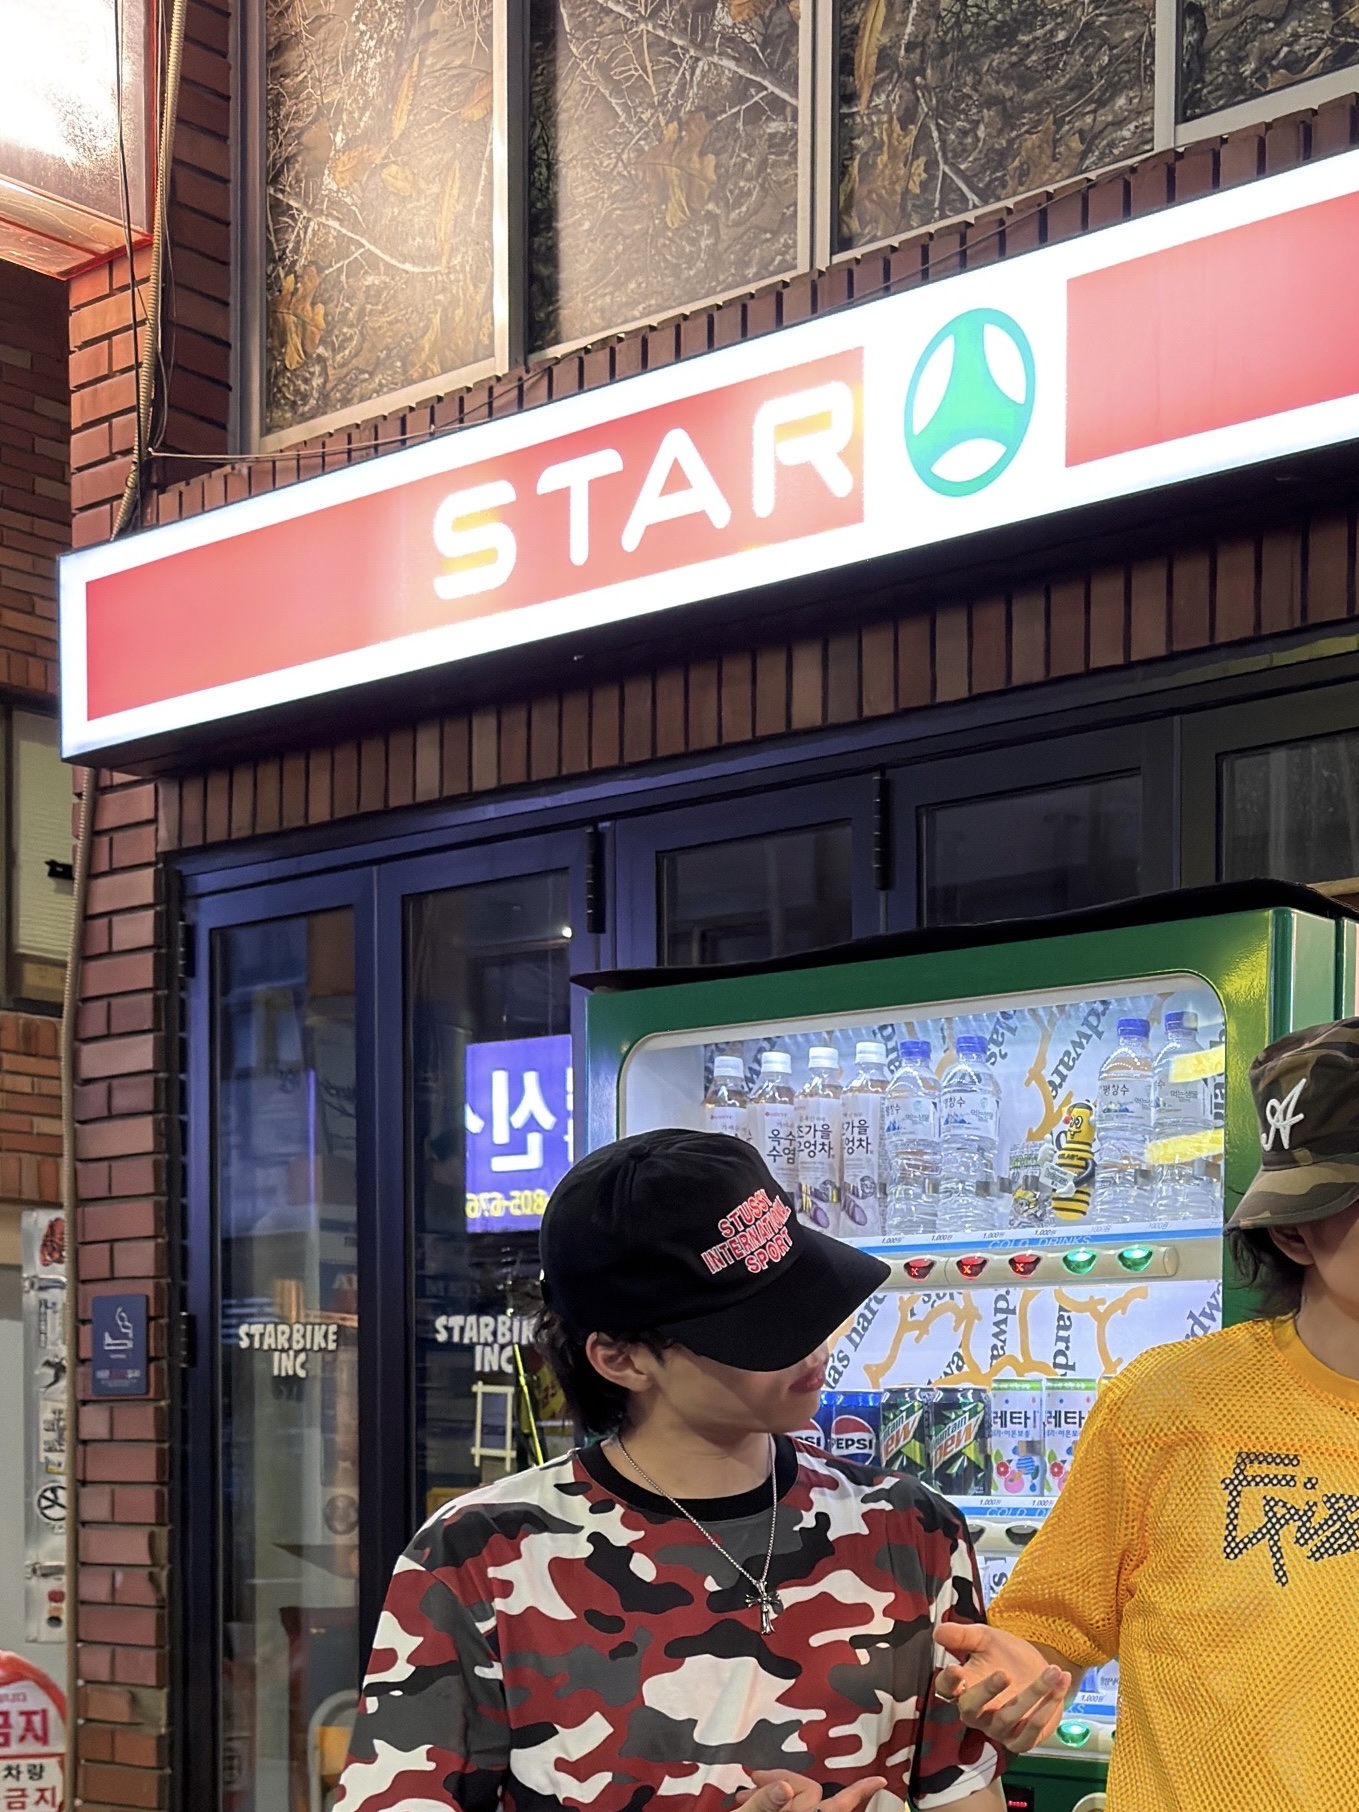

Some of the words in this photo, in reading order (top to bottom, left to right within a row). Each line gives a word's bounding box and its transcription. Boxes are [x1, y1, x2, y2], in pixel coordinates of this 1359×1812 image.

[431, 380, 855, 601] STAR
[717, 1187, 774, 1239] STUSSY
[744, 1225, 794, 1274] SPORT
[988, 1238, 1029, 1249] COLD
[1038, 1234, 1093, 1247] DRINKS
[238, 1322, 338, 1351] STARBIKE
[434, 1313, 534, 1345] STARBIK
[272, 1350, 307, 1378] INC
[473, 1345, 514, 1373] INC
[4, 1785, 57, 1810] 금지
